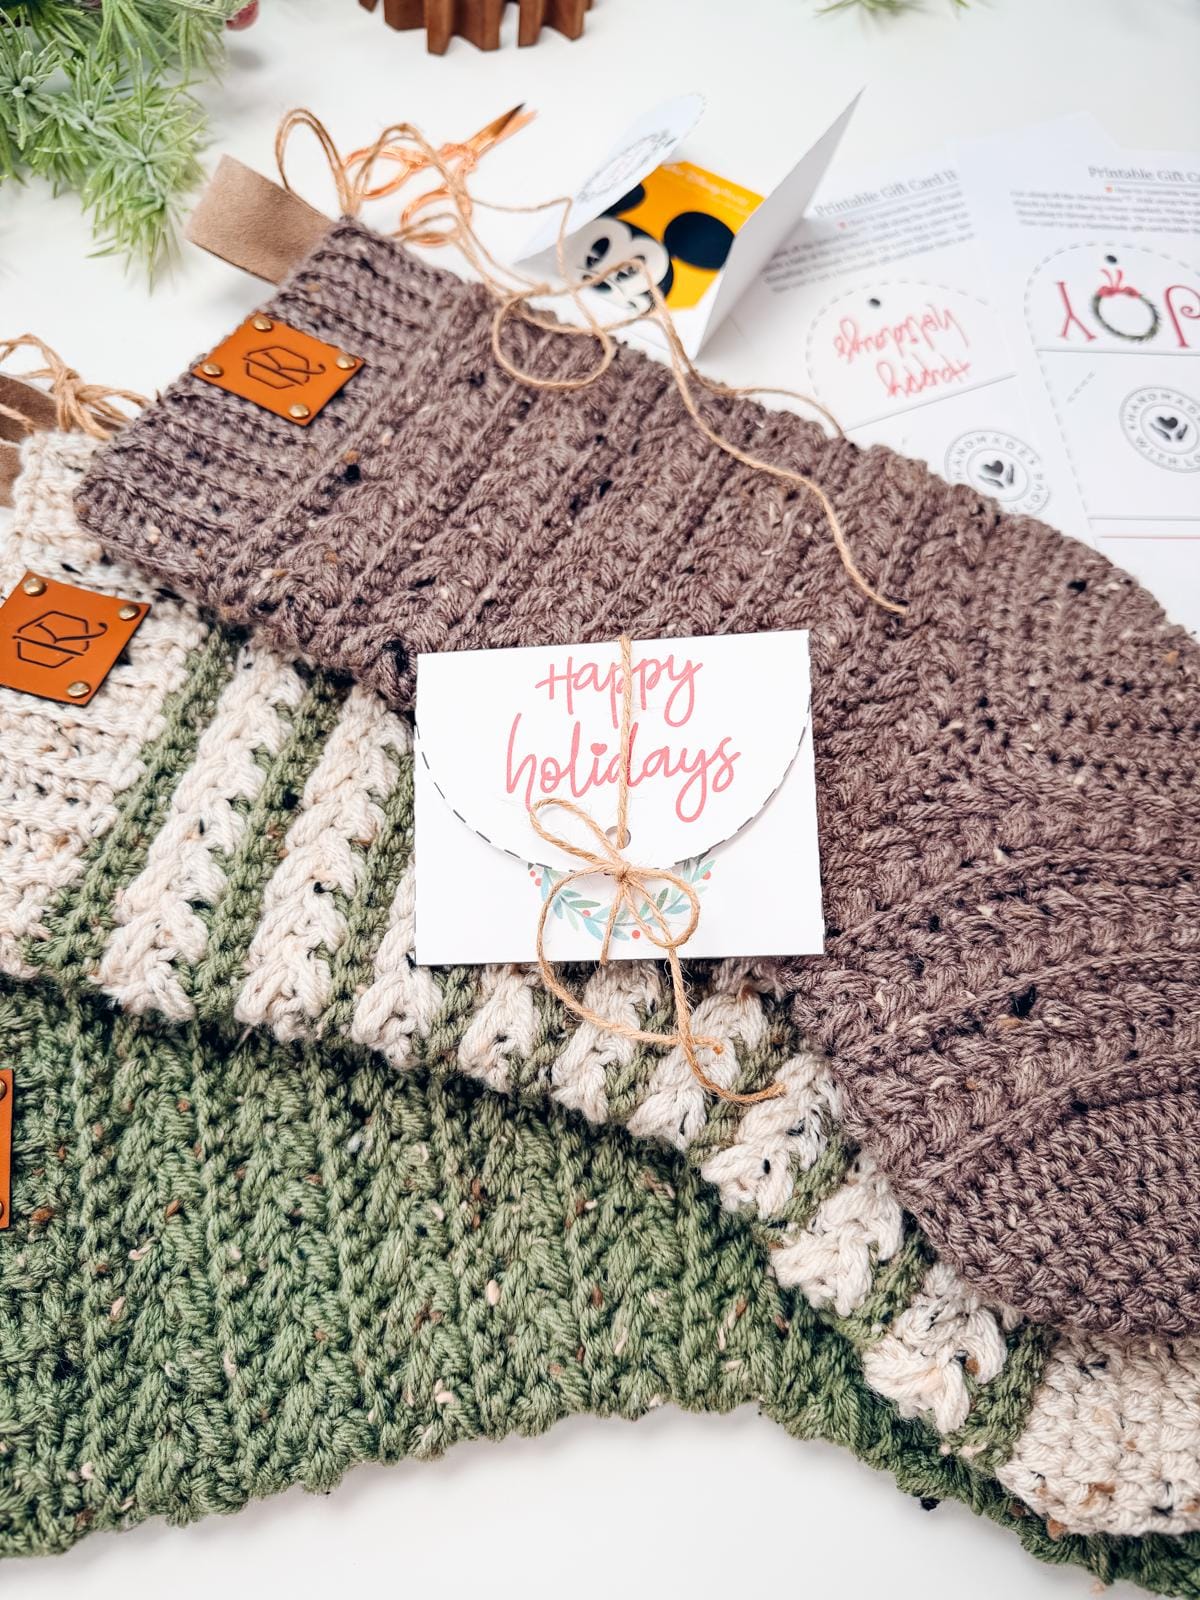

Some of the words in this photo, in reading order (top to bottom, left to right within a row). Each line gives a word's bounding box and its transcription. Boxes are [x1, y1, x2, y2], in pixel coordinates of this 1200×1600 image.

[814, 191, 880, 218] Printable
[880, 181, 906, 200] Gift
[908, 171, 943, 193] Card
[1088, 165, 1155, 182] Printable
[1156, 170, 1184, 183] Gift
[876, 352, 971, 398] Happy
[535, 653, 704, 728] Happy
[506, 712, 741, 823] holidays
